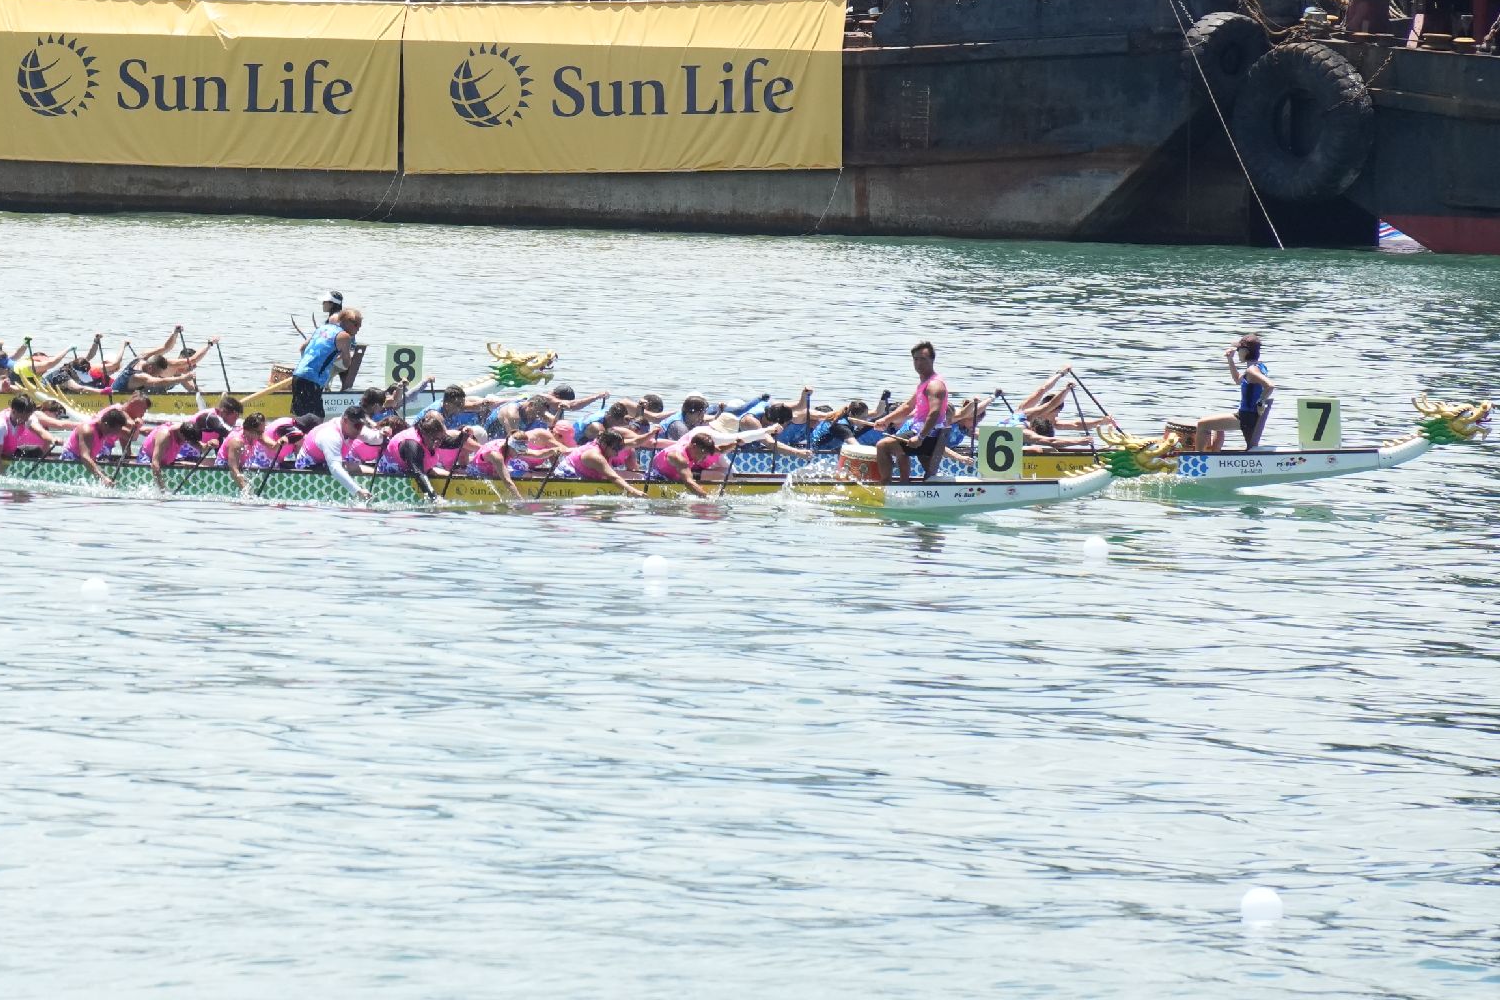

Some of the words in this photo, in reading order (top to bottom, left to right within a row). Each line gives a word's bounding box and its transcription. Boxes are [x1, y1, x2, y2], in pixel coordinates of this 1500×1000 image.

[117, 59, 228, 112] Sun
[245, 59, 353, 115] Life
[552, 65, 667, 118] Sun
[684, 57, 794, 115] Life
[392, 348, 416, 384] 8
[1306, 402, 1332, 441] 7
[986, 430, 1014, 472] 6
